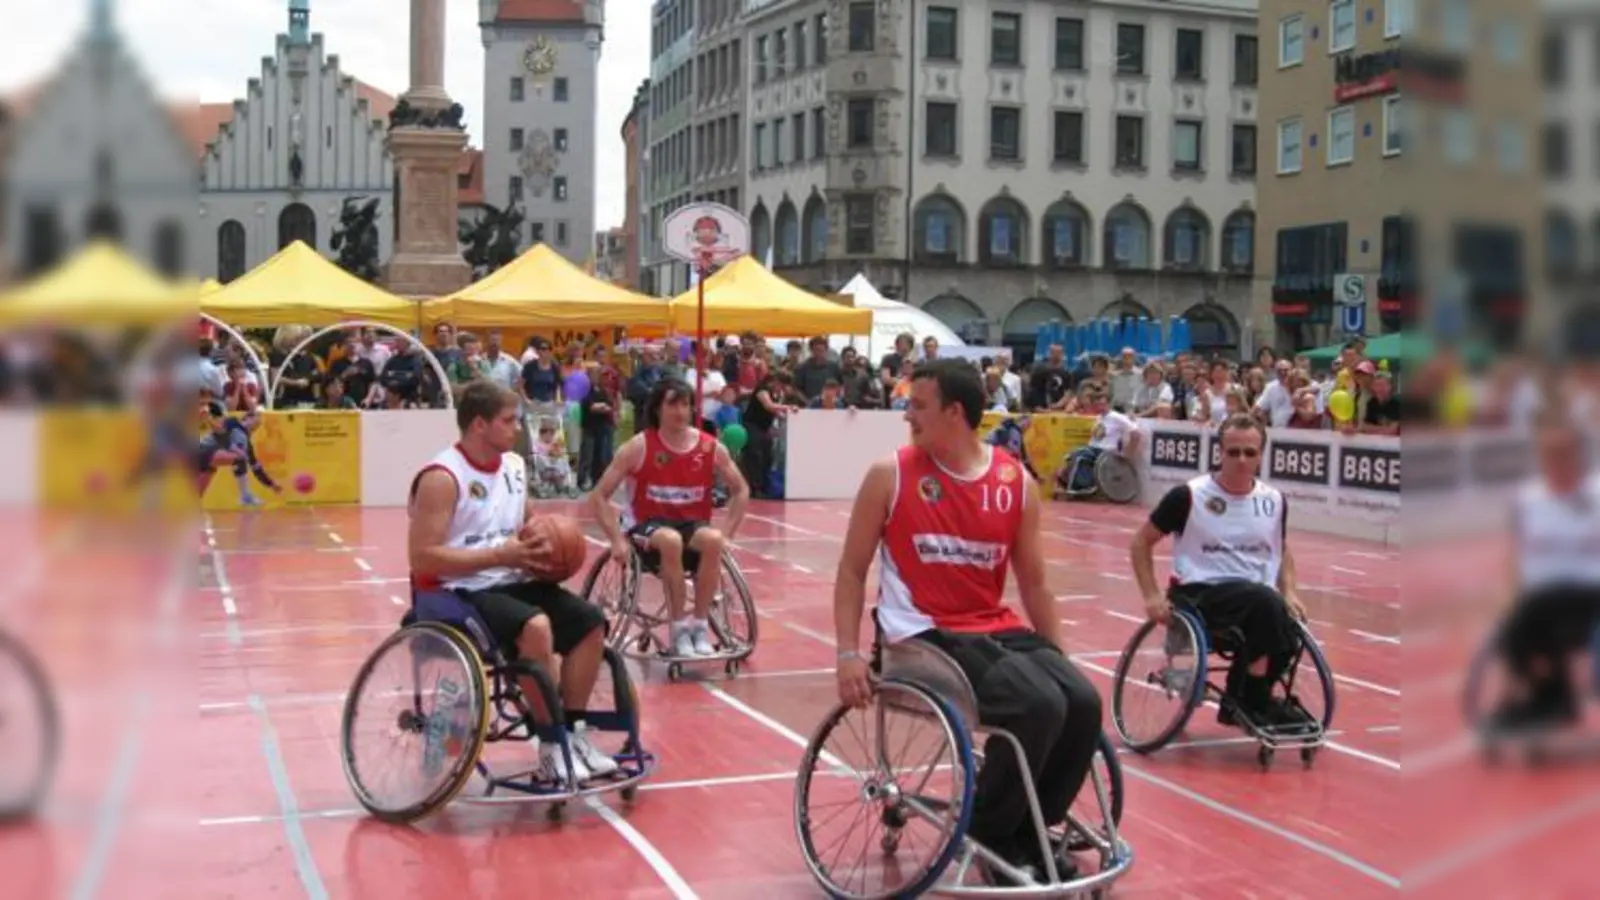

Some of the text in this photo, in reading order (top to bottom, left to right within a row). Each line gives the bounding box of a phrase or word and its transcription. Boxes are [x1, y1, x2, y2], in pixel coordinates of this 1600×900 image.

[1344, 276, 1363, 299] S
[1345, 305, 1362, 331] U
[1154, 439, 1197, 463] BASE
[1273, 449, 1325, 477] BASE
[1343, 455, 1400, 485] BASE
[980, 484, 1012, 513] 10
[1252, 495, 1276, 518] 10
